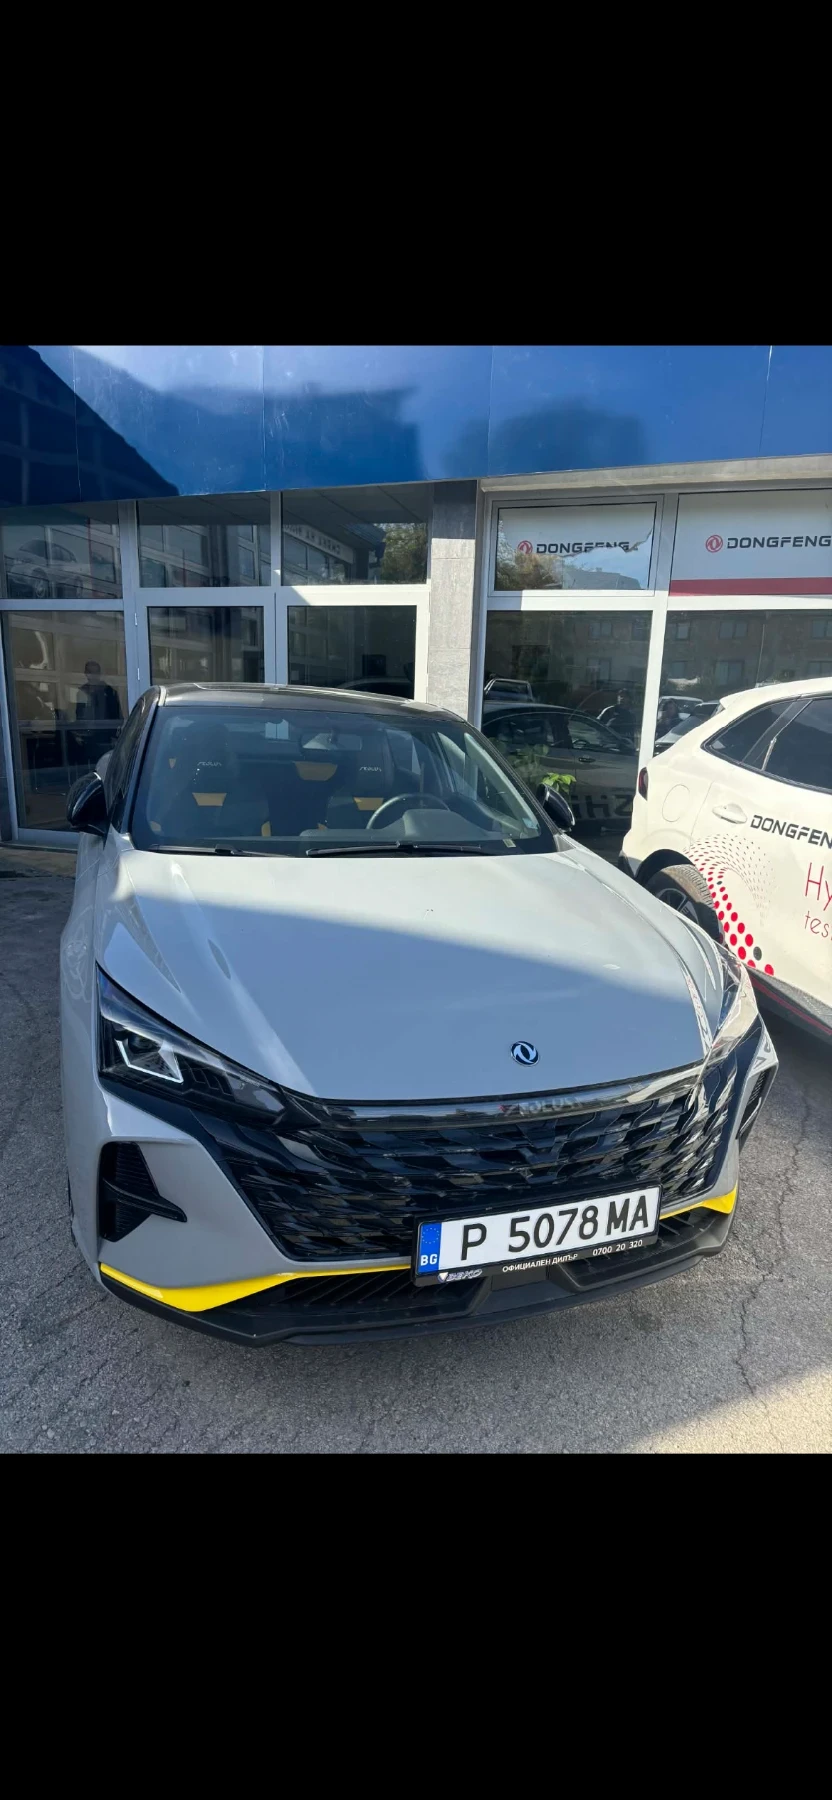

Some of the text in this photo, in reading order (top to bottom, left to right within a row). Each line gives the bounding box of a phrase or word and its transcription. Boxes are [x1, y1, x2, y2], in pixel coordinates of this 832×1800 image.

[727, 535, 832, 549] DONGFENG
[460, 1195, 649, 1261] P 5078 MA
[592, 1240, 643, 1257] 0700 20 320
[420, 1253, 438, 1266] BG
[502, 1259, 551, 1273] ОФИЦИАЛЕН
